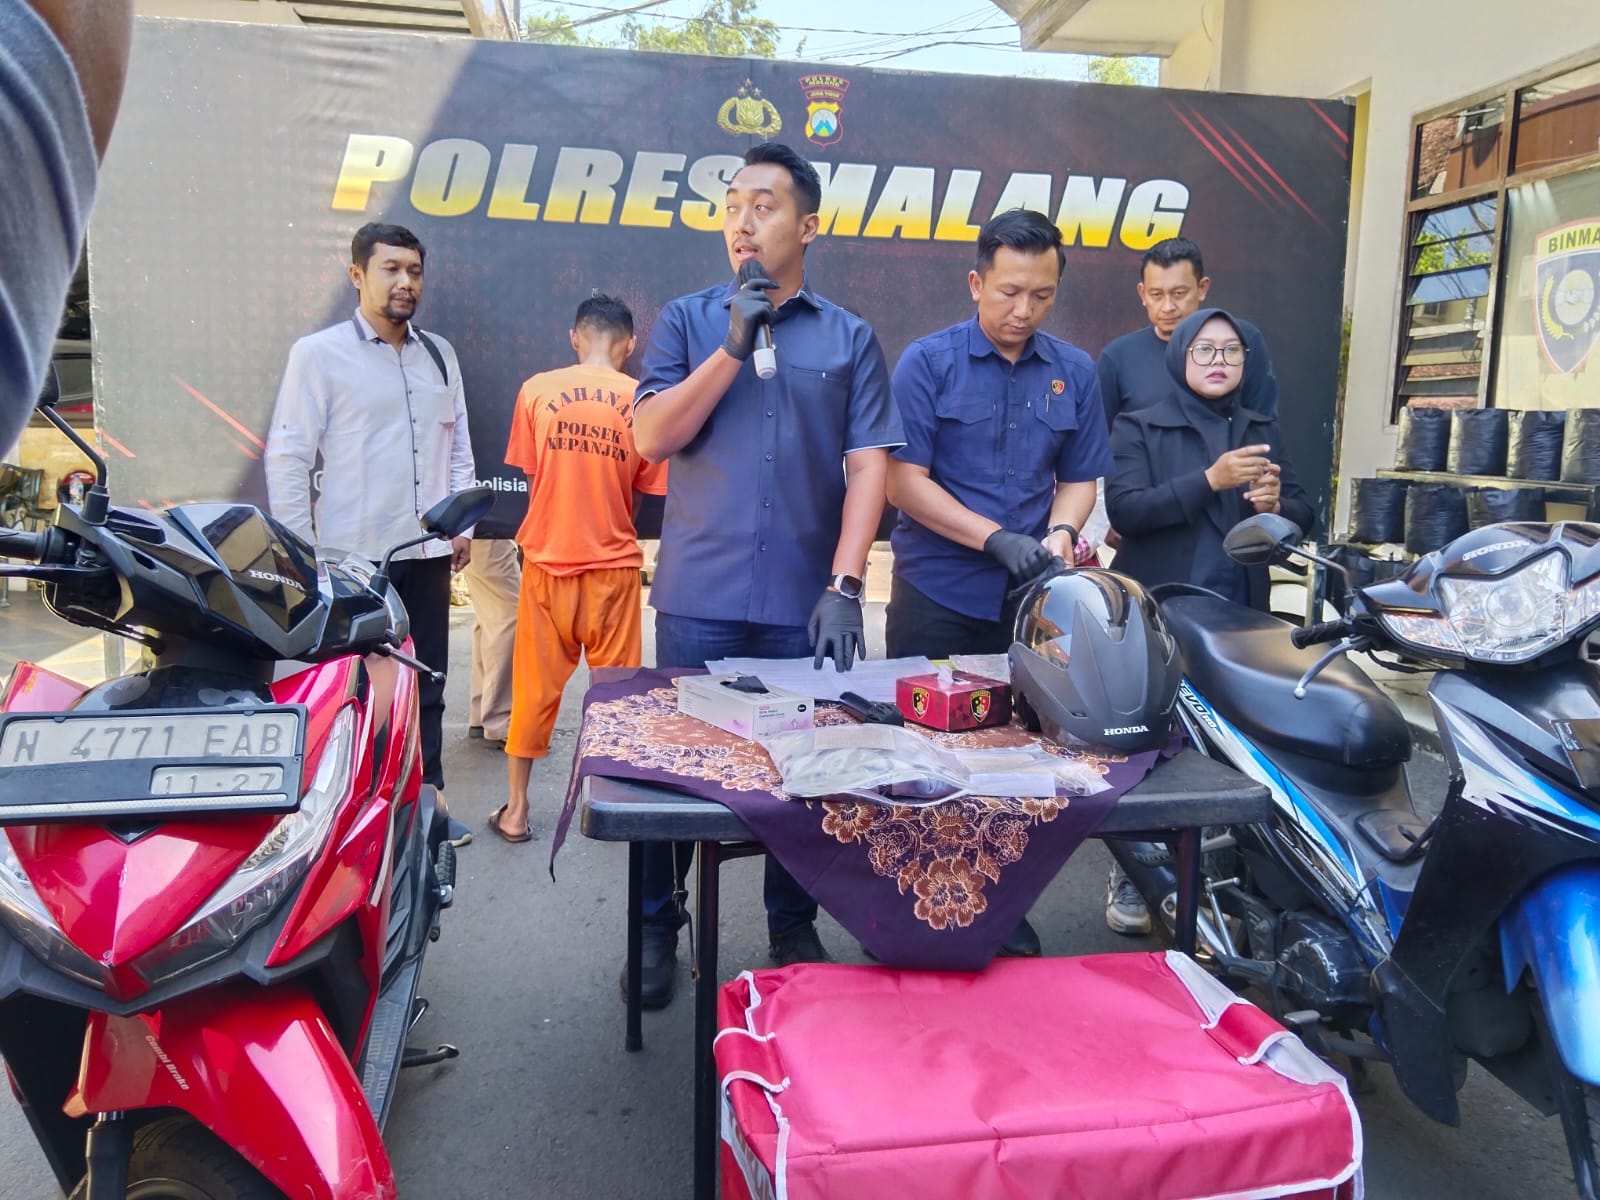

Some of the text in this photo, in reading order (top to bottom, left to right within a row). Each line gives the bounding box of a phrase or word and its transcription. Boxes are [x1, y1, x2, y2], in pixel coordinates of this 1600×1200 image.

[331, 133, 756, 232] POLRES
[557, 421, 622, 445] POLSEK
[547, 437, 630, 462] KEPANJEN
[1463, 540, 1531, 561] HONDA
[249, 568, 307, 592] HONDA
[1179, 680, 1208, 713] EVO
[12, 723, 283, 762] N 4771 EAB
[1103, 725, 1149, 736] HONDA
[165, 1063, 190, 1090] Brake
